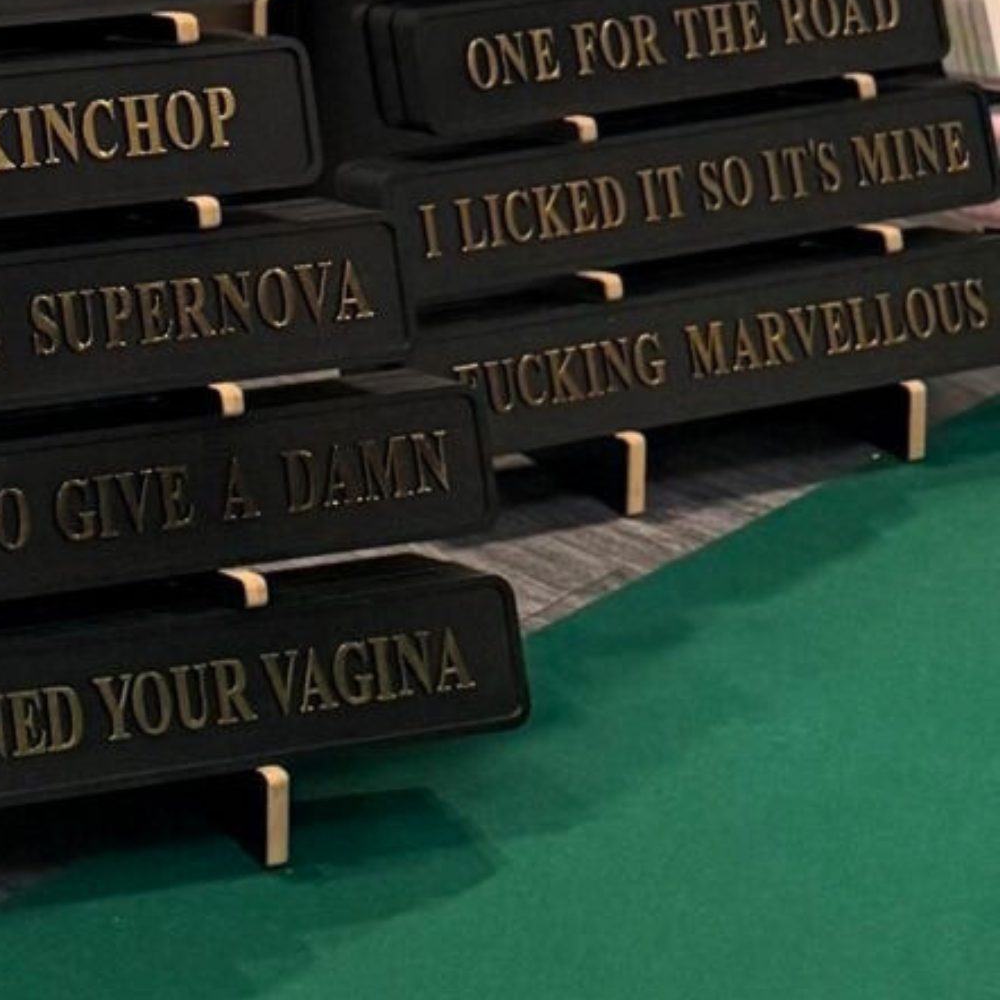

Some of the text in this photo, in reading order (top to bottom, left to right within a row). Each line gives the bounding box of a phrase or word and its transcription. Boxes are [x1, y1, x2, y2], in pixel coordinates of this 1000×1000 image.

[466, 28, 561, 91] ONE
[571, 15, 667, 78] FOR
[418, 121, 971, 260] I LICKED IT SO IT'S MINE
[31, 259, 374, 356] SUPERNOVA
[685, 278, 990, 380] MARVELLOUS
[54, 460, 195, 541] GIVE
[223, 458, 261, 520] A
[282, 429, 450, 514] DAMN
[93, 661, 258, 742] YOUR
[261, 627, 476, 716] VAGINA
